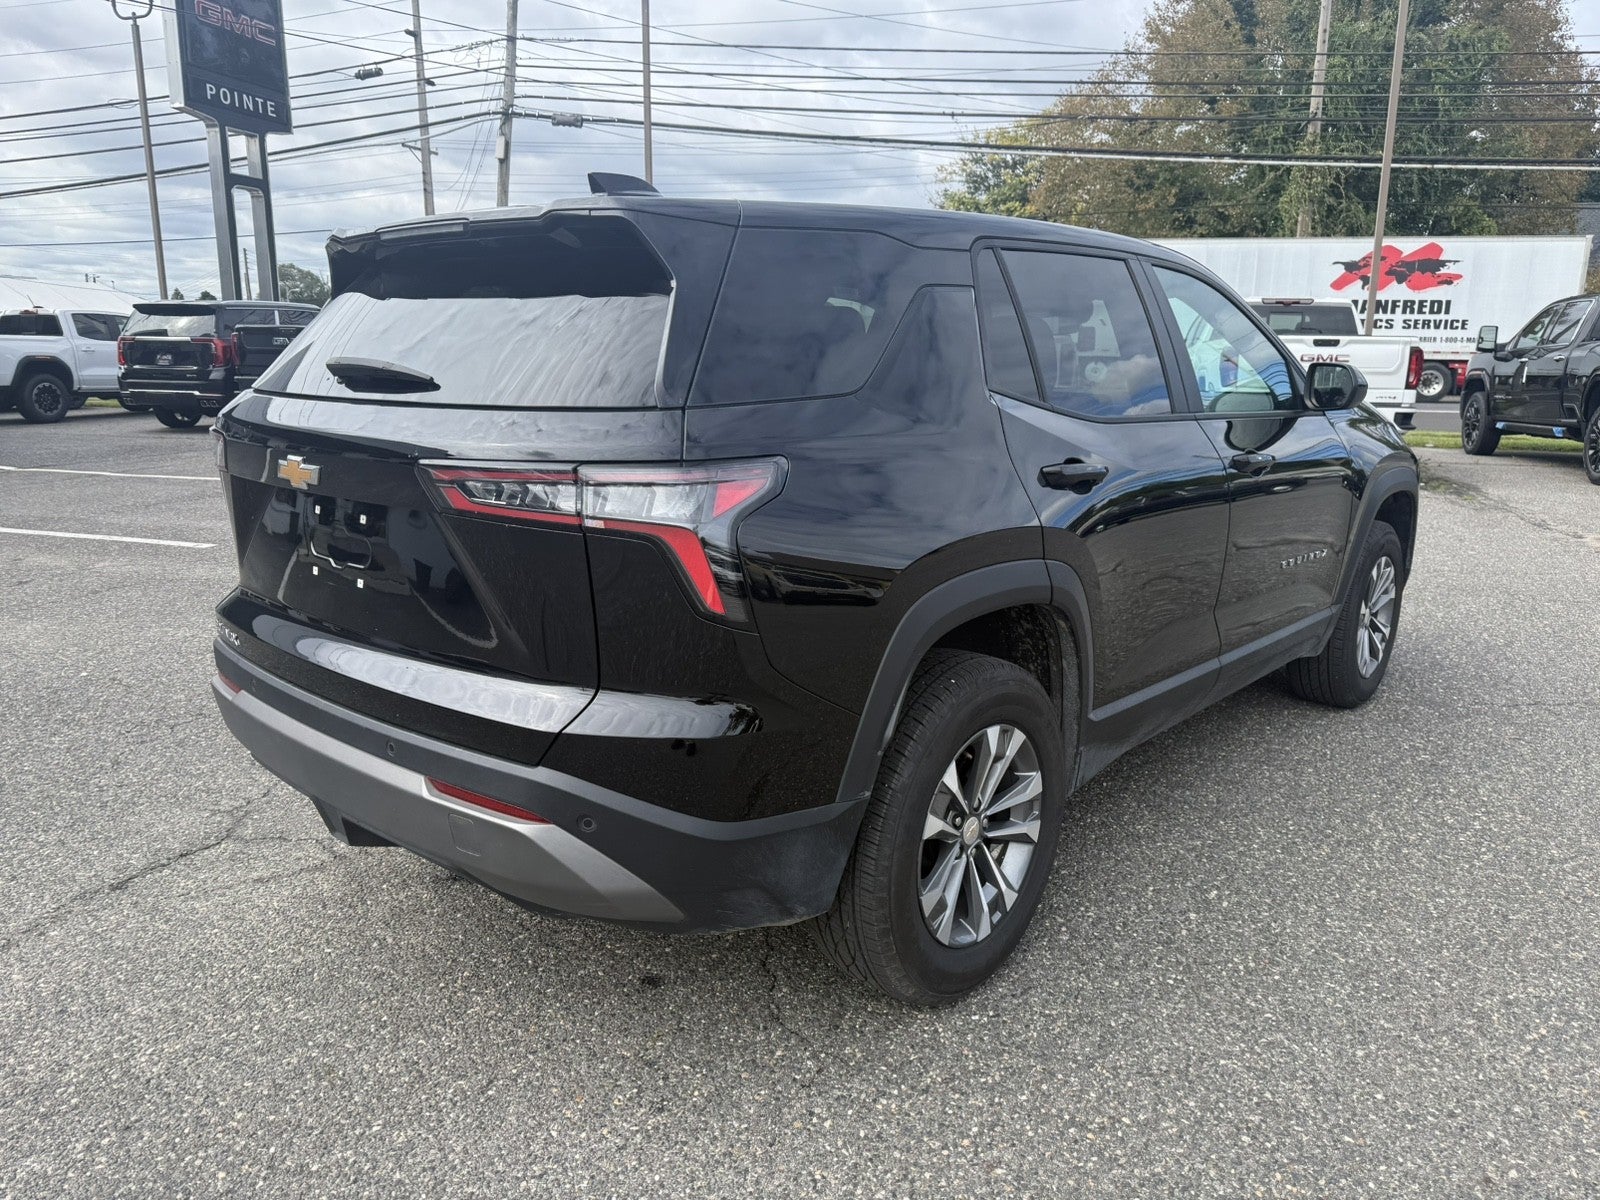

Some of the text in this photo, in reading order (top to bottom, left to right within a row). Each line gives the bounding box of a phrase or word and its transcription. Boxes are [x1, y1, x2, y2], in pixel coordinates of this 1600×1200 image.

[195, 0, 276, 46] GMC
[205, 83, 277, 117] POINTE
[1401, 319, 1470, 331] SERVICE
[1300, 353, 1350, 363] GMC
